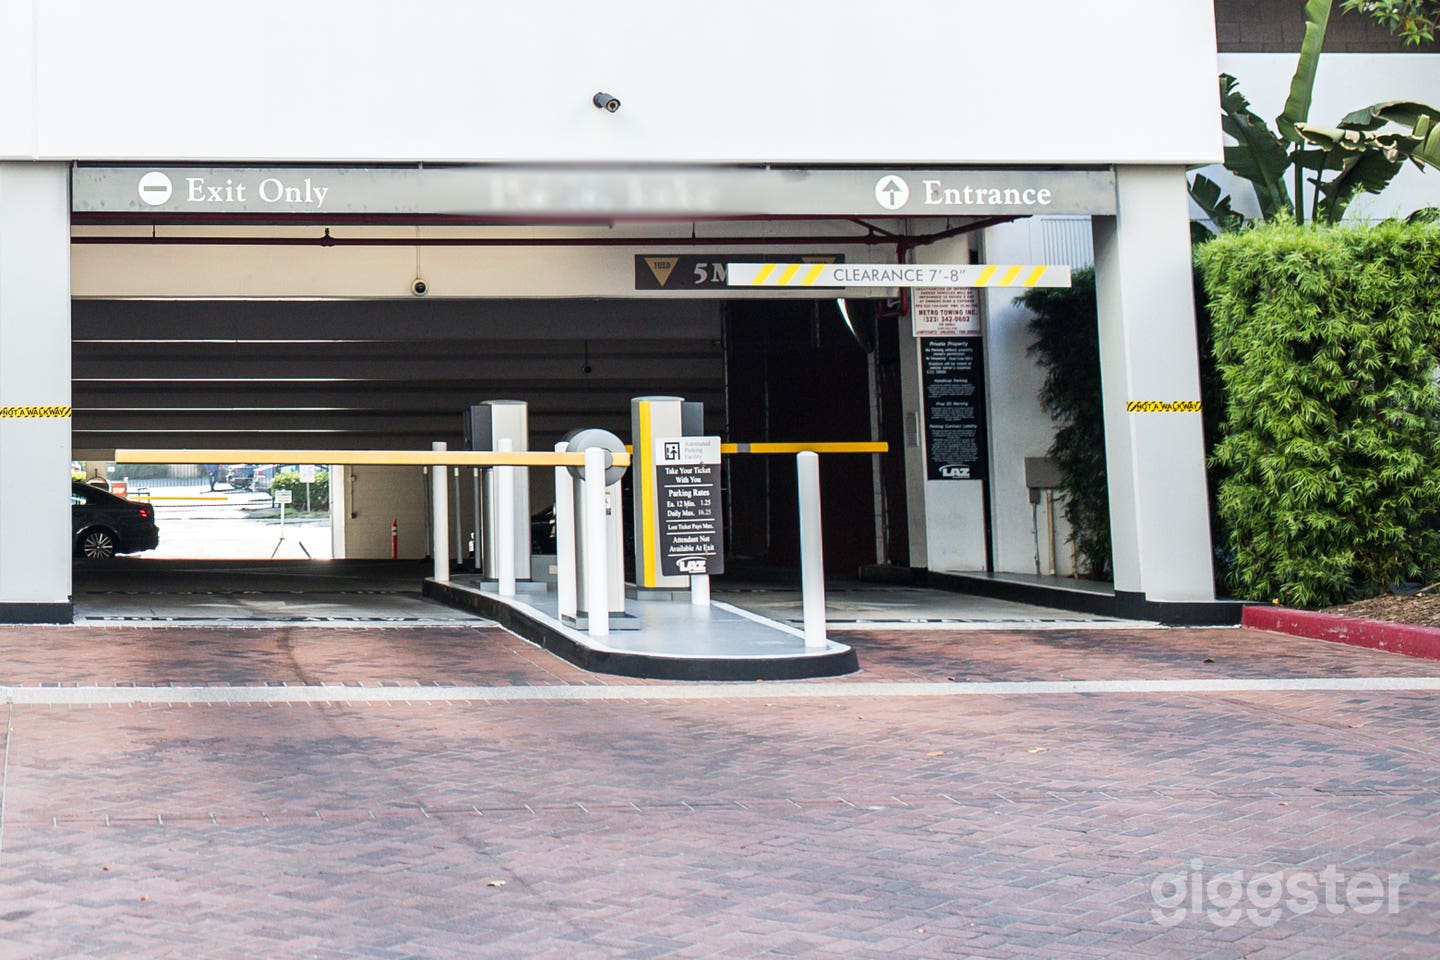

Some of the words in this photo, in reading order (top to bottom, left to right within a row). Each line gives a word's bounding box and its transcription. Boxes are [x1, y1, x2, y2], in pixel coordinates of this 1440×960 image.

[186, 178, 246, 202] Exit
[259, 178, 328, 208] Only
[922, 180, 1051, 205] Entrance
[833, 269, 923, 282] CLEARANCE
[693, 466, 711, 474] Ticket
[942, 468, 970, 477] LAZ
[669, 489, 692, 498] Parking
[667, 510, 681, 518] Daily
[679, 560, 706, 572] LAZ
